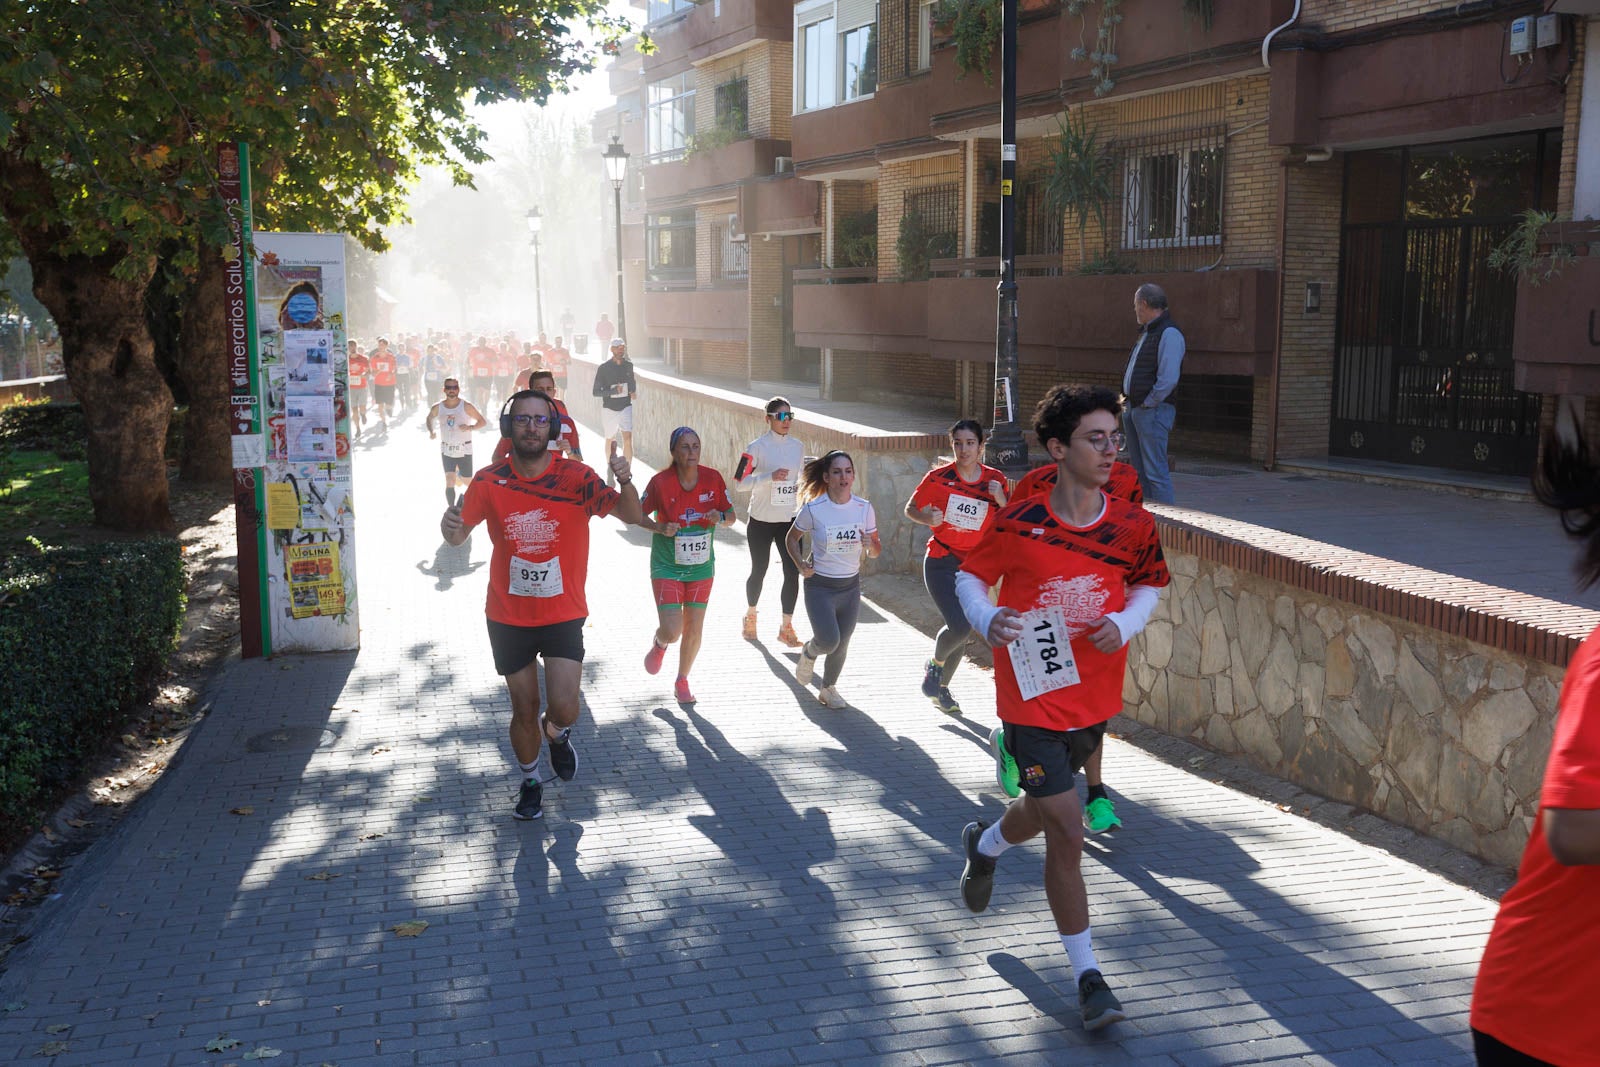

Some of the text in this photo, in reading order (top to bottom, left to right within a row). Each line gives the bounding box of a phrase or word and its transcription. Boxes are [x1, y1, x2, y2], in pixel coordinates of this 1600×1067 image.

[1462, 194, 1473, 214] 2
[226, 198, 243, 294] Saluabs
[957, 503, 977, 515] 463
[507, 522, 554, 532] carrera
[836, 530, 857, 540] 442
[292, 547, 331, 557] MOLINA
[681, 541, 707, 552] 1152
[318, 557, 333, 575] B
[521, 568, 549, 581] 937
[1040, 592, 1105, 606] carrera
[1034, 619, 1064, 675] 1784
